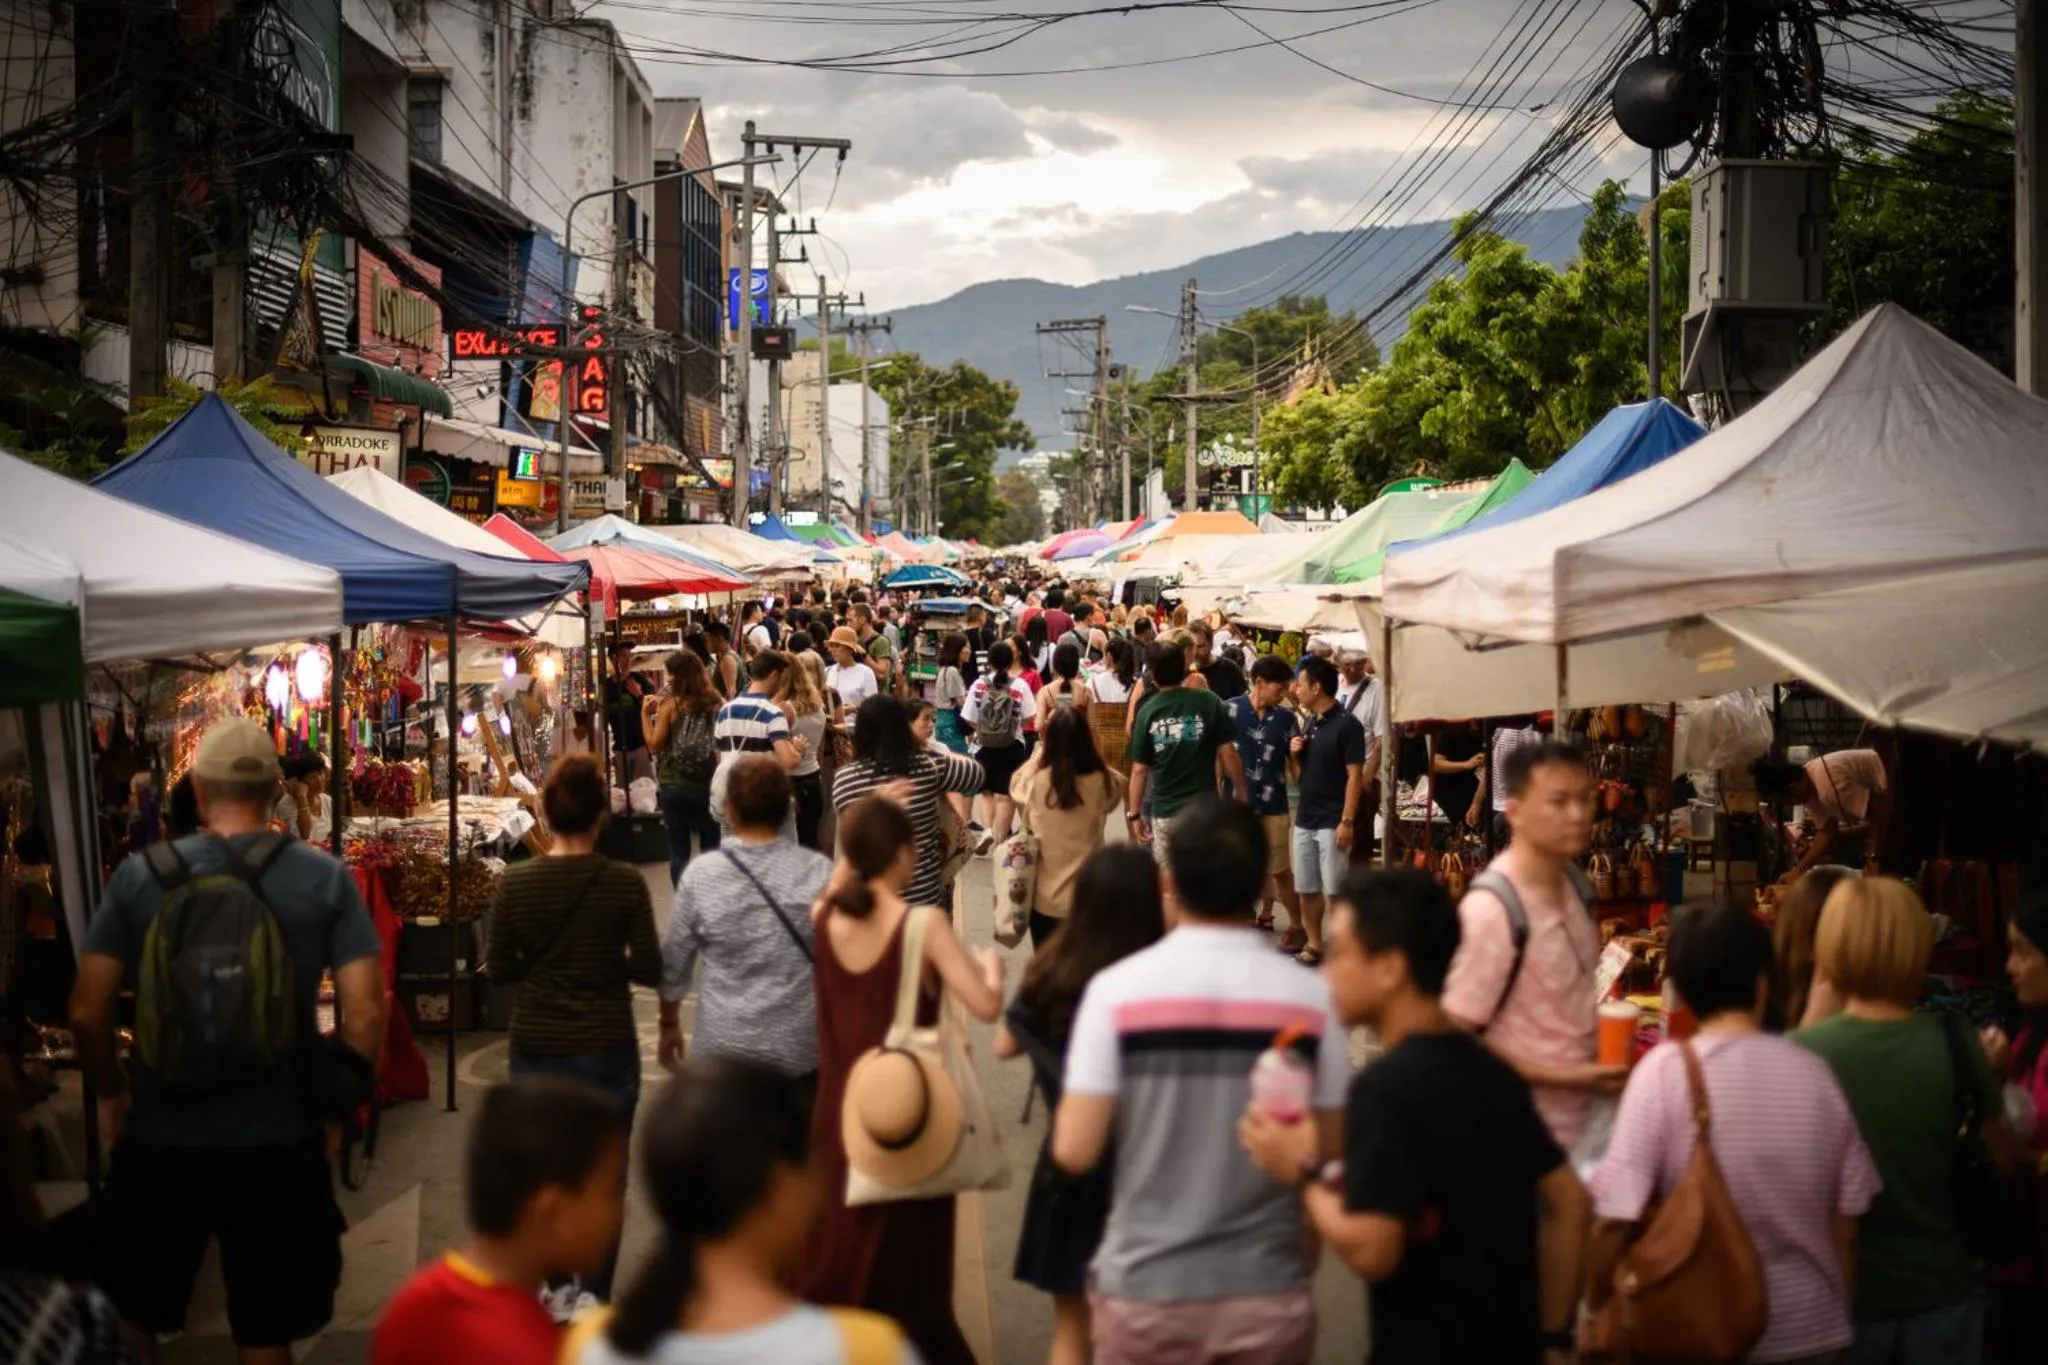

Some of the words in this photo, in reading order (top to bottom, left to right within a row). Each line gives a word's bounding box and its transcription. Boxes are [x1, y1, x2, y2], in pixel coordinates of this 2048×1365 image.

[314, 434, 390, 450] ORRADOKE
[307, 451, 381, 475] THAI
[573, 481, 607, 493] THAI
